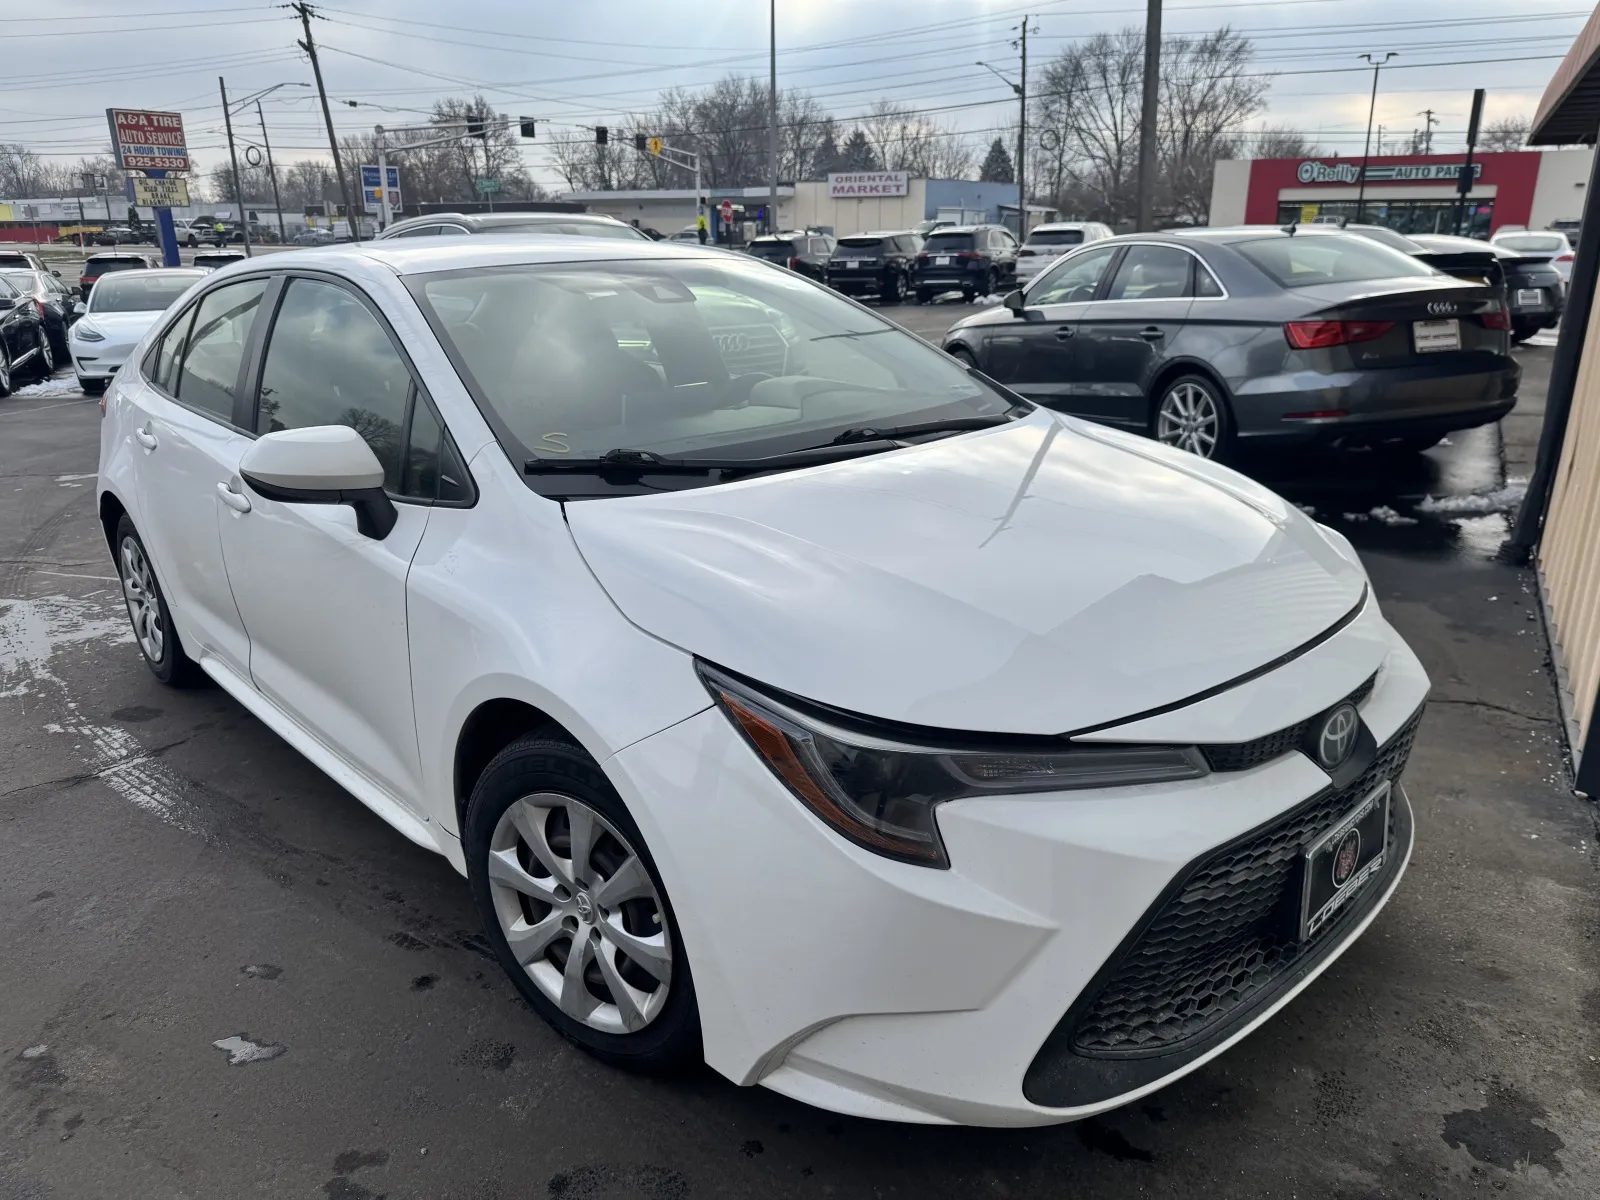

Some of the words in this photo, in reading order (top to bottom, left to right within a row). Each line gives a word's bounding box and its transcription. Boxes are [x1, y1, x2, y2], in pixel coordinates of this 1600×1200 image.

[118, 114, 148, 126] A&A
[150, 115, 181, 128] TIRE
[120, 129, 145, 143] AUTO
[147, 131, 184, 145] SERVICE
[121, 145, 132, 154] 24
[133, 146, 155, 155] HOUR
[157, 147, 186, 156] TOWING
[128, 157, 185, 167] 925-5330
[1298, 161, 1360, 183] O'Reilly
[1394, 166, 1432, 180] AUTO
[1435, 164, 1481, 179] PARS
[835, 174, 902, 184] ORIENTAL
[832, 184, 904, 195] MARKET
[1309, 857, 1383, 937] LOEBER
